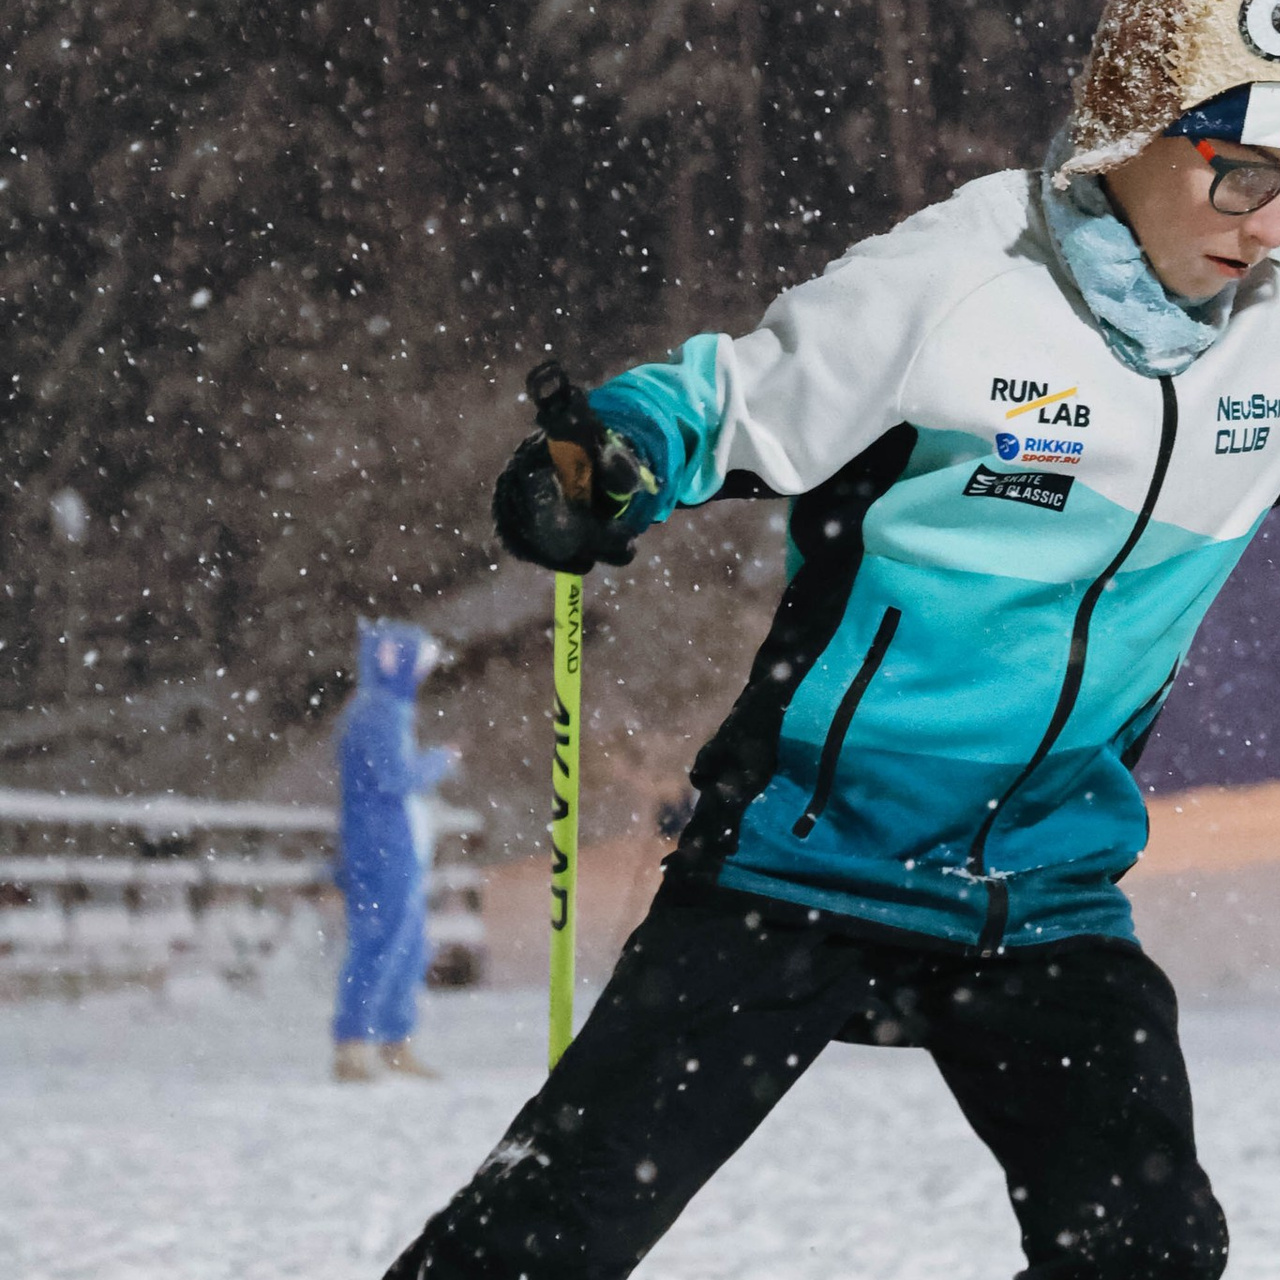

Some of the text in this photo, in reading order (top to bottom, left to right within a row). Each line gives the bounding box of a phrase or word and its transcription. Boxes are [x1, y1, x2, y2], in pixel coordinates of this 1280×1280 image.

[990, 377, 1049, 402] RUN
[1037, 402, 1091, 428] LAB
[1024, 437, 1084, 455] RIKKIR
[1214, 426, 1271, 455] CLUB
[1020, 453, 1081, 465] SPORT.RU
[1000, 474, 1044, 485] SKATE
[1005, 484, 1064, 507] CLASSIC
